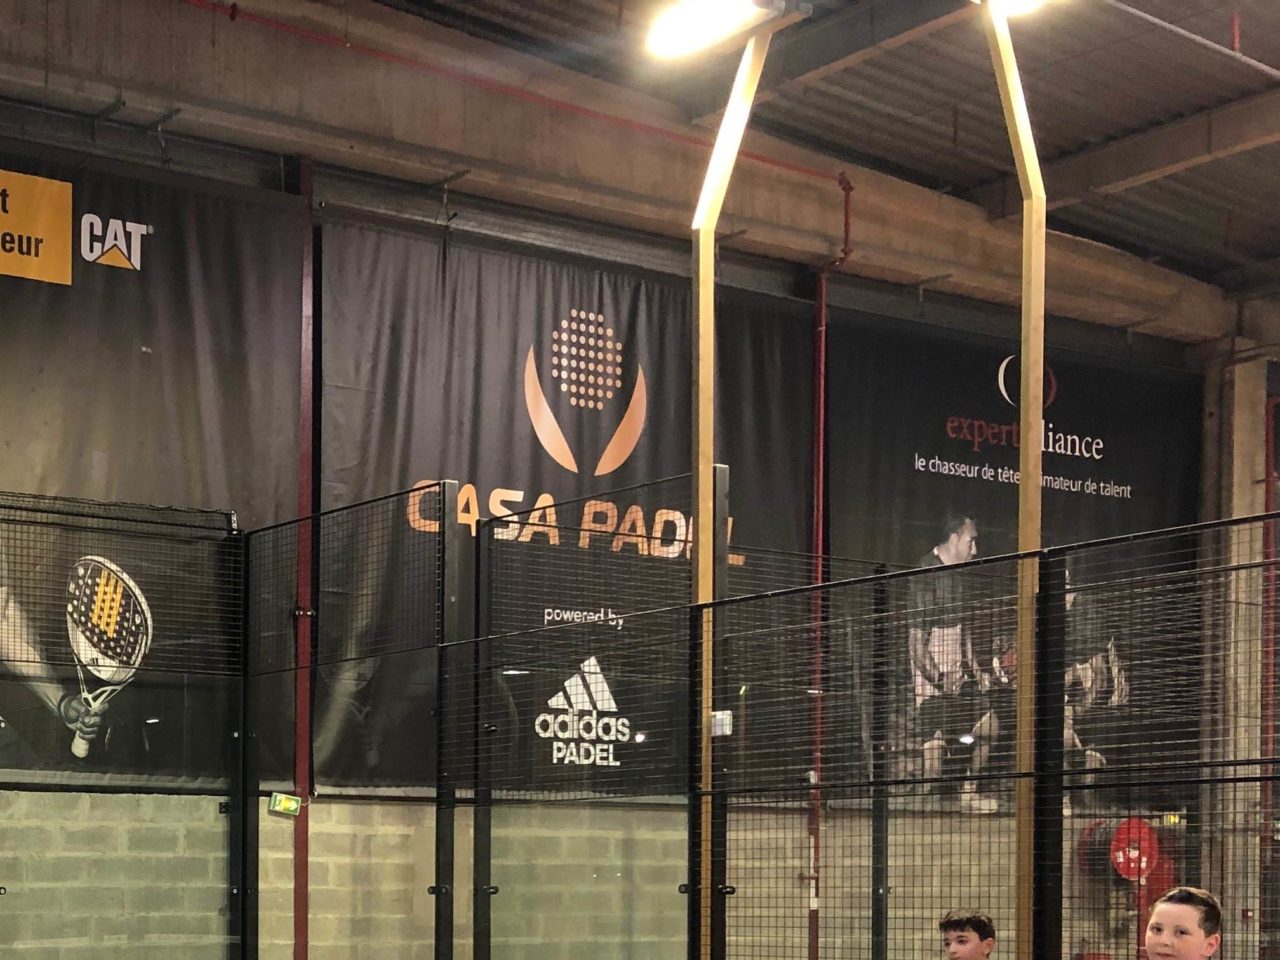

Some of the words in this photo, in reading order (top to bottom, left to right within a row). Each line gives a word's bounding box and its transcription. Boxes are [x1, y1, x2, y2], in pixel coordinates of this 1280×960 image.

[914, 453, 926, 470] le
[929, 456, 979, 478] chasseur
[982, 463, 995, 480] de
[1084, 478, 1097, 495] de
[1100, 481, 1131, 498] talent
[406, 479, 560, 546] CASA
[578, 499, 745, 566] PADL
[544, 607, 604, 626] powered
[608, 608, 624, 630] by
[534, 708, 631, 742] adidas
[552, 741, 621, 766] PADEL
